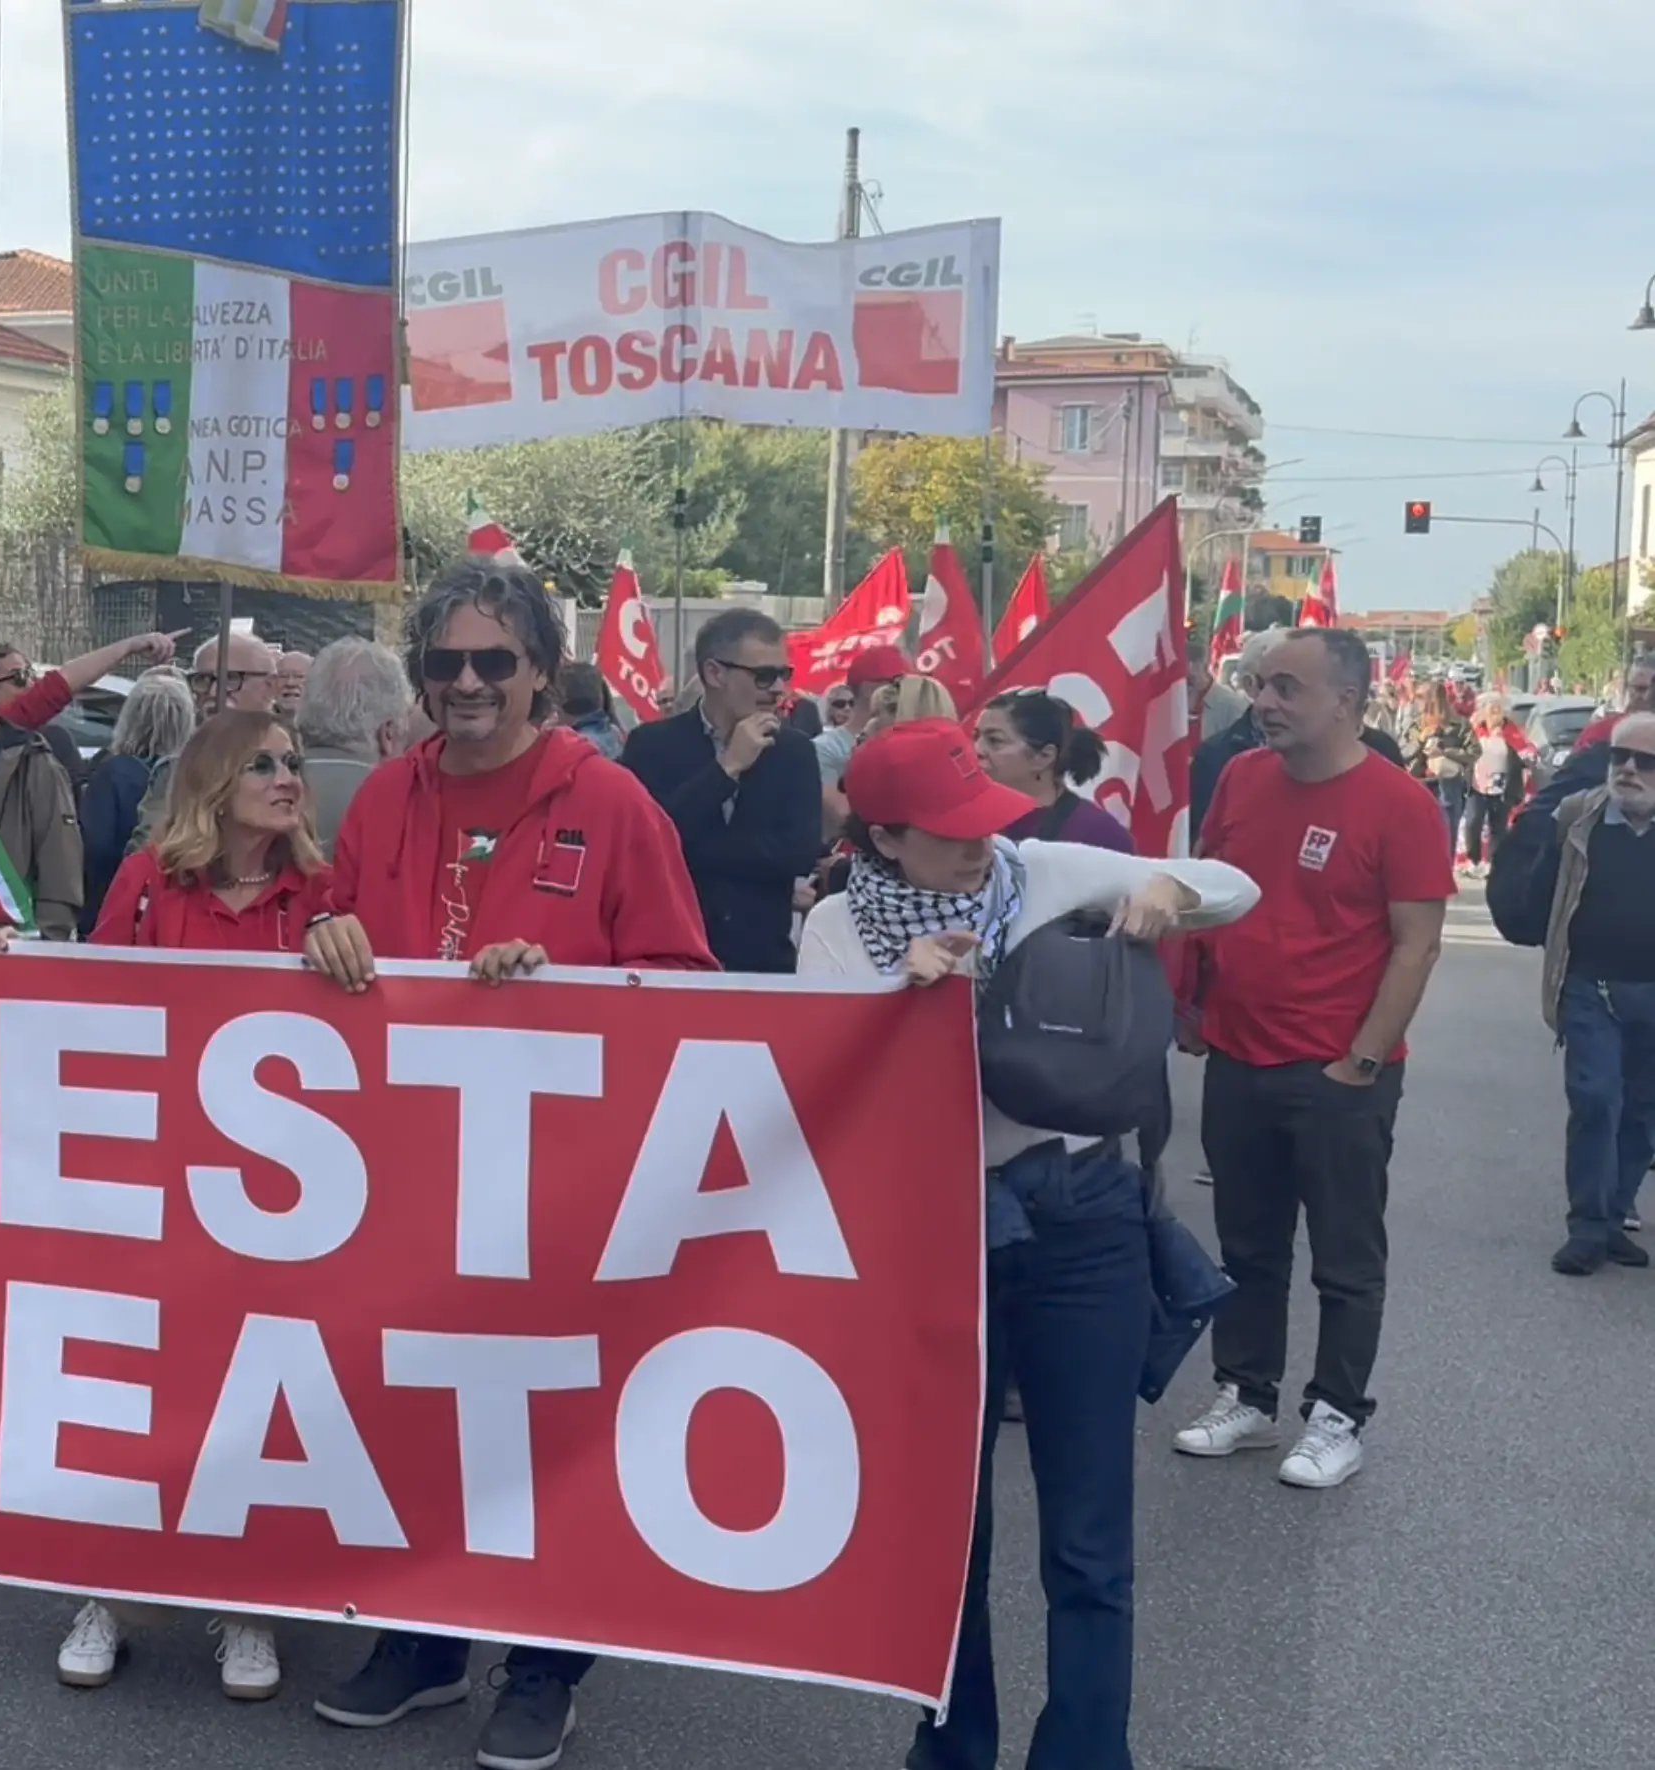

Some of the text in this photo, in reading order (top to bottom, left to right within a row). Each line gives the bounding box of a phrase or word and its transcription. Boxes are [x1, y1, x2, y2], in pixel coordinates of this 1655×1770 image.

[97, 269, 158, 292] UNITI
[599, 241, 769, 316] CGIL
[858, 255, 963, 287] CGIL
[406, 266, 503, 305] CGIL
[97, 305, 139, 328] PER
[147, 304, 174, 328] LA
[117, 342, 145, 364] LA
[527, 324, 843, 401] TOSCANA
[227, 415, 302, 439] GOTICA
